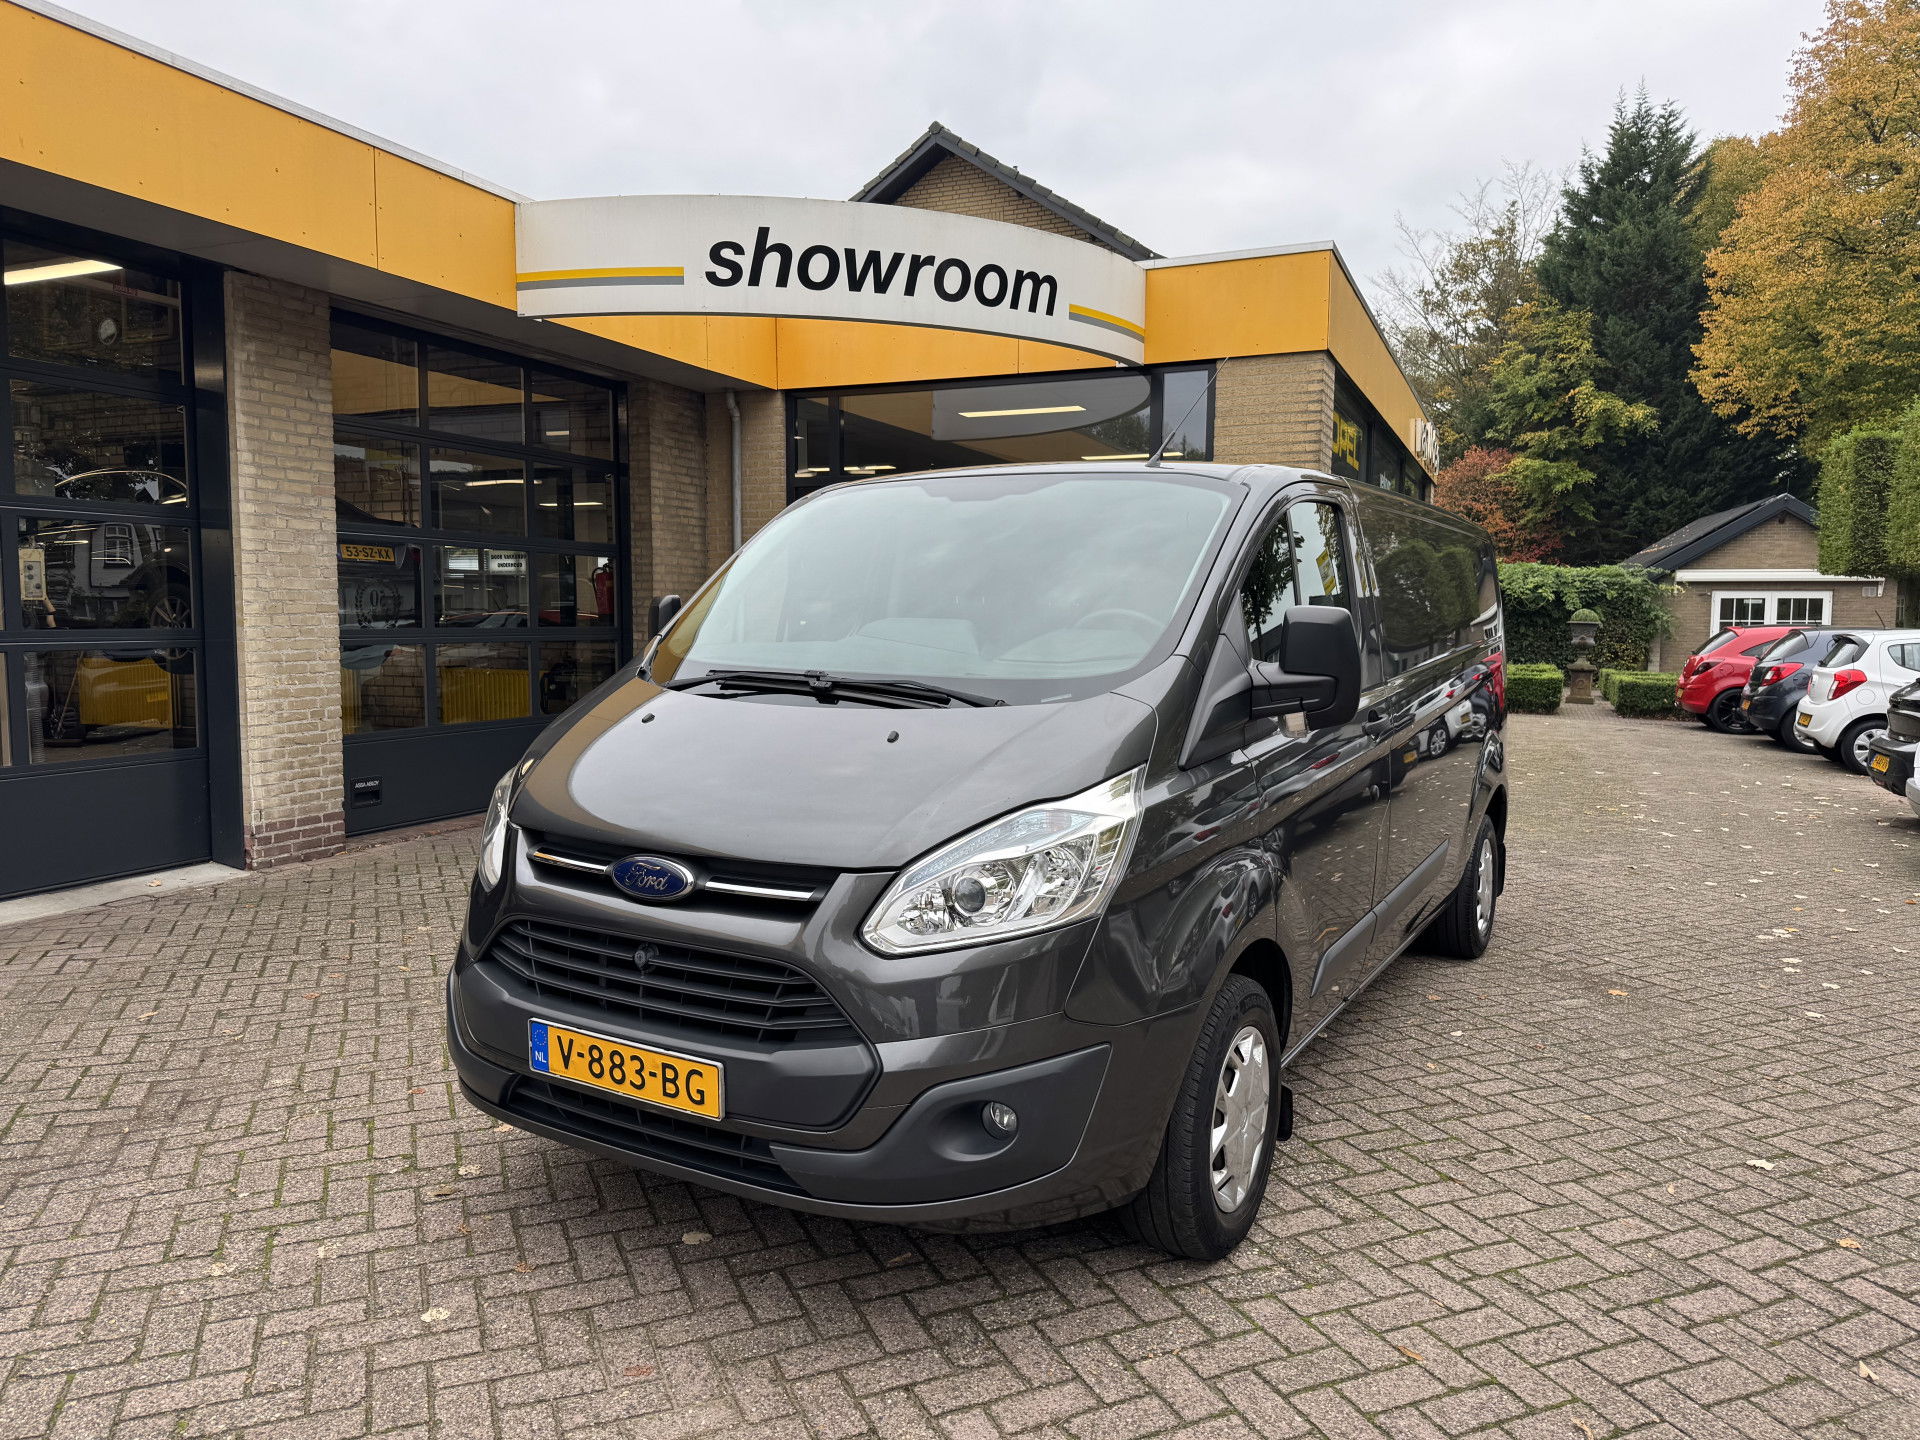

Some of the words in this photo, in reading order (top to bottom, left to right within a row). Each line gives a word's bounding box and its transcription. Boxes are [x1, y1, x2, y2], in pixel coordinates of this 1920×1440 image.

[704, 226, 1059, 317] showroom
[345, 546, 391, 560] 53-SZ-KX
[625, 862, 671, 891] Ford
[534, 1051, 547, 1064] NL
[556, 1034, 705, 1106] V-883-BG
